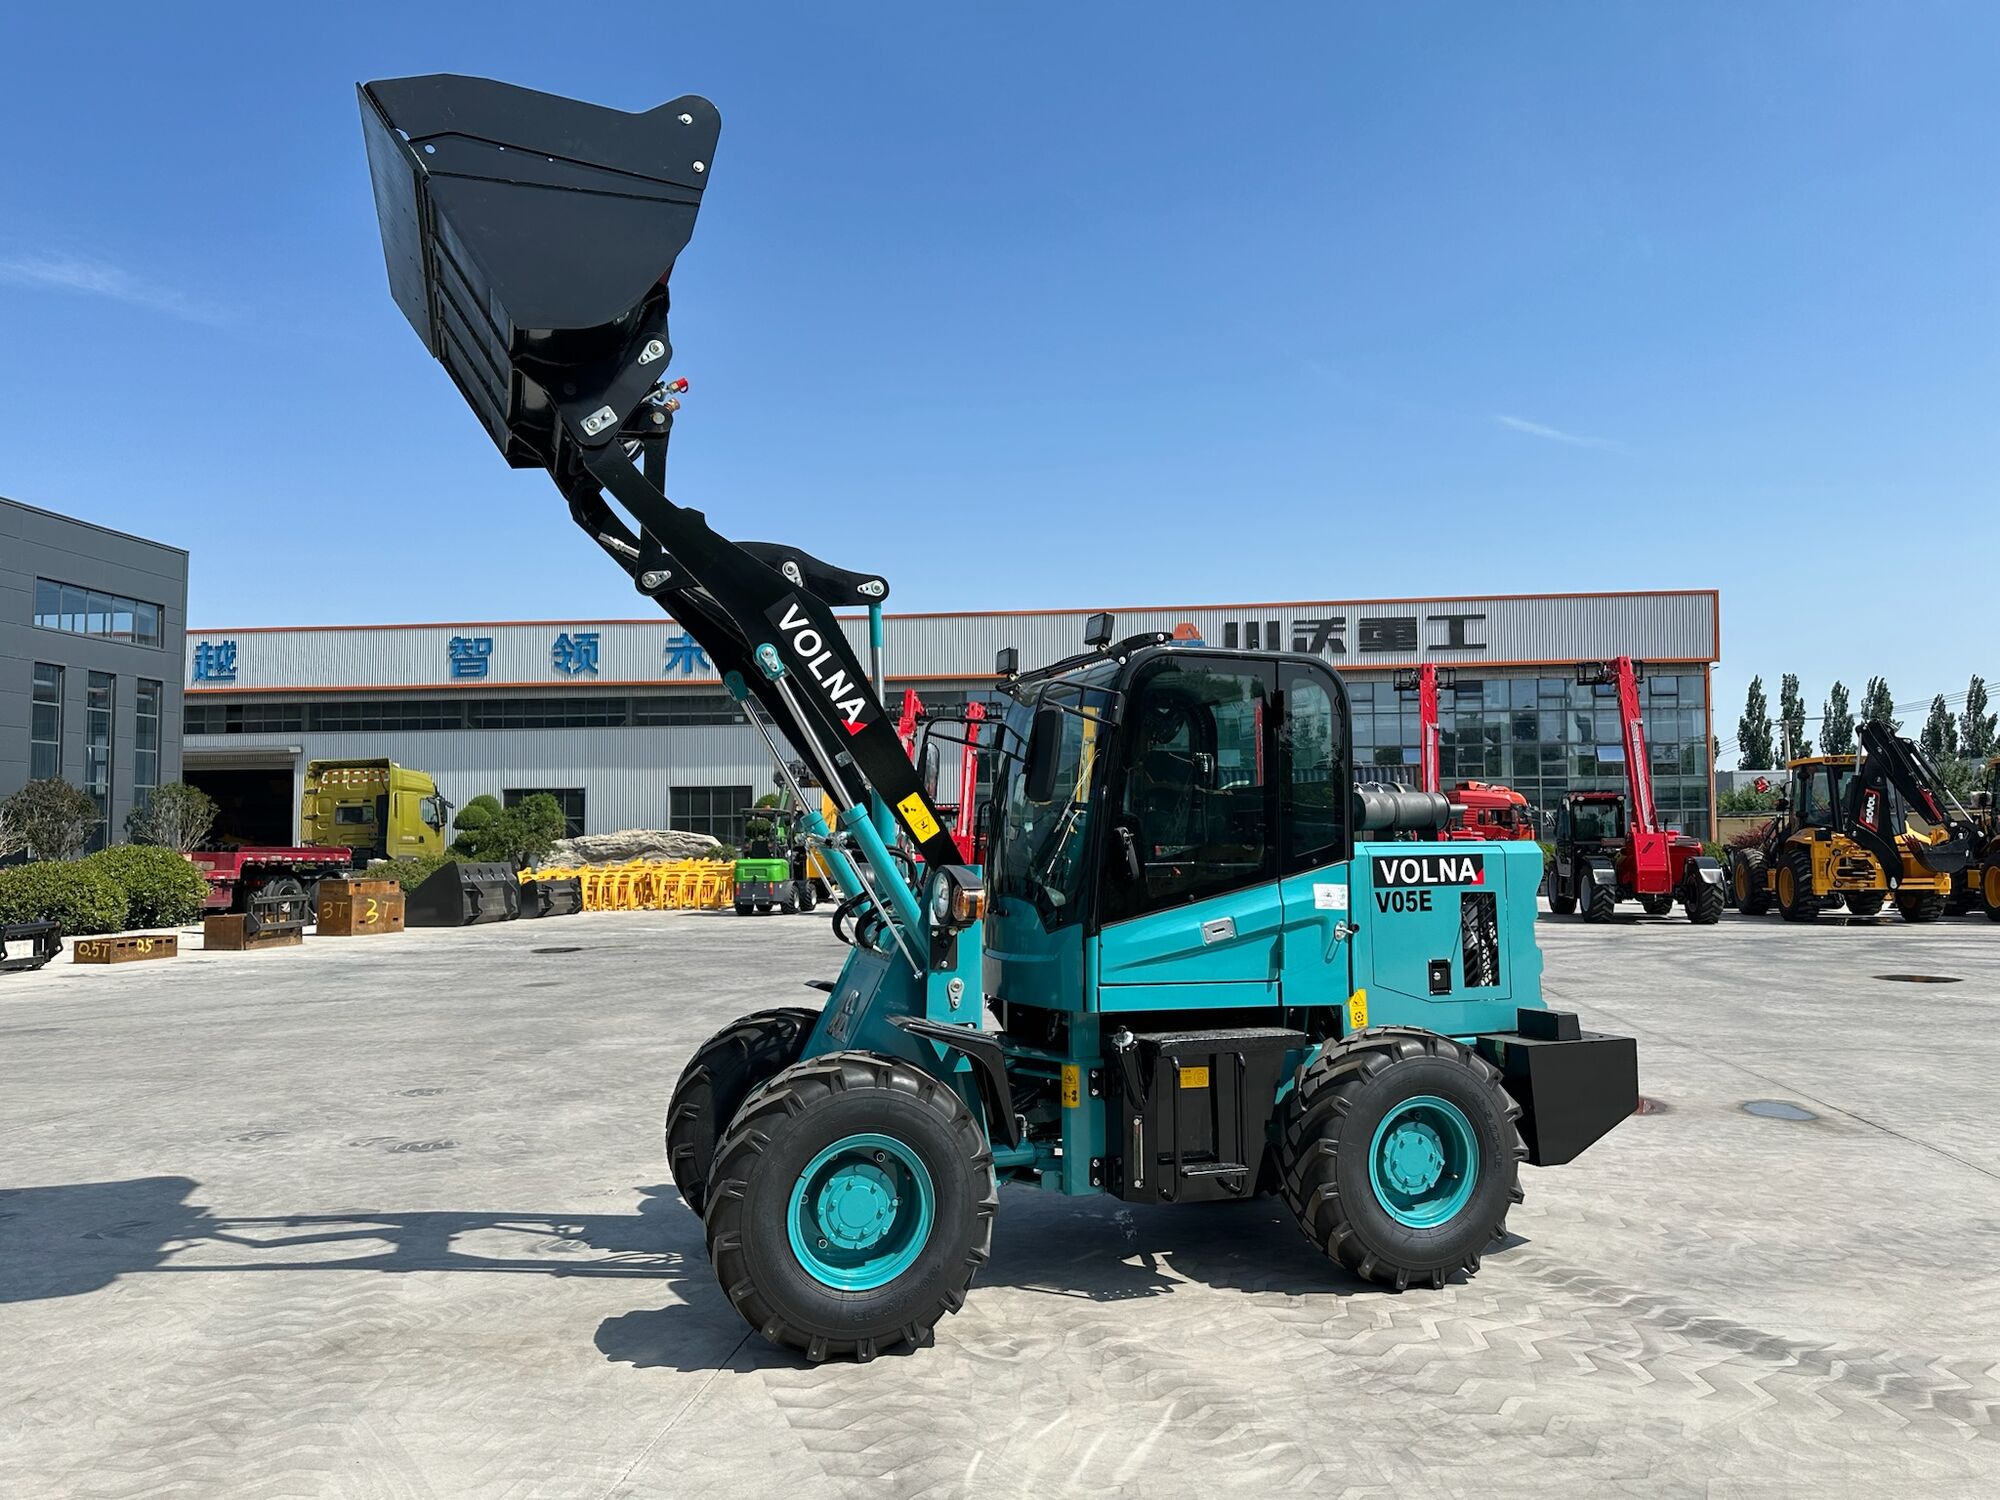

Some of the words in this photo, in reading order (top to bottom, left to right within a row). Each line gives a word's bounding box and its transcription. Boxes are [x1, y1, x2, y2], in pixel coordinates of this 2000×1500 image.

[193, 640, 238, 681] 越
[778, 602, 866, 726] VOLNA
[1379, 857, 1478, 884] VOLNA
[323, 901, 348, 919] 3T
[1375, 890, 1433, 913] V05E
[79, 942, 110, 958] 0.5T
